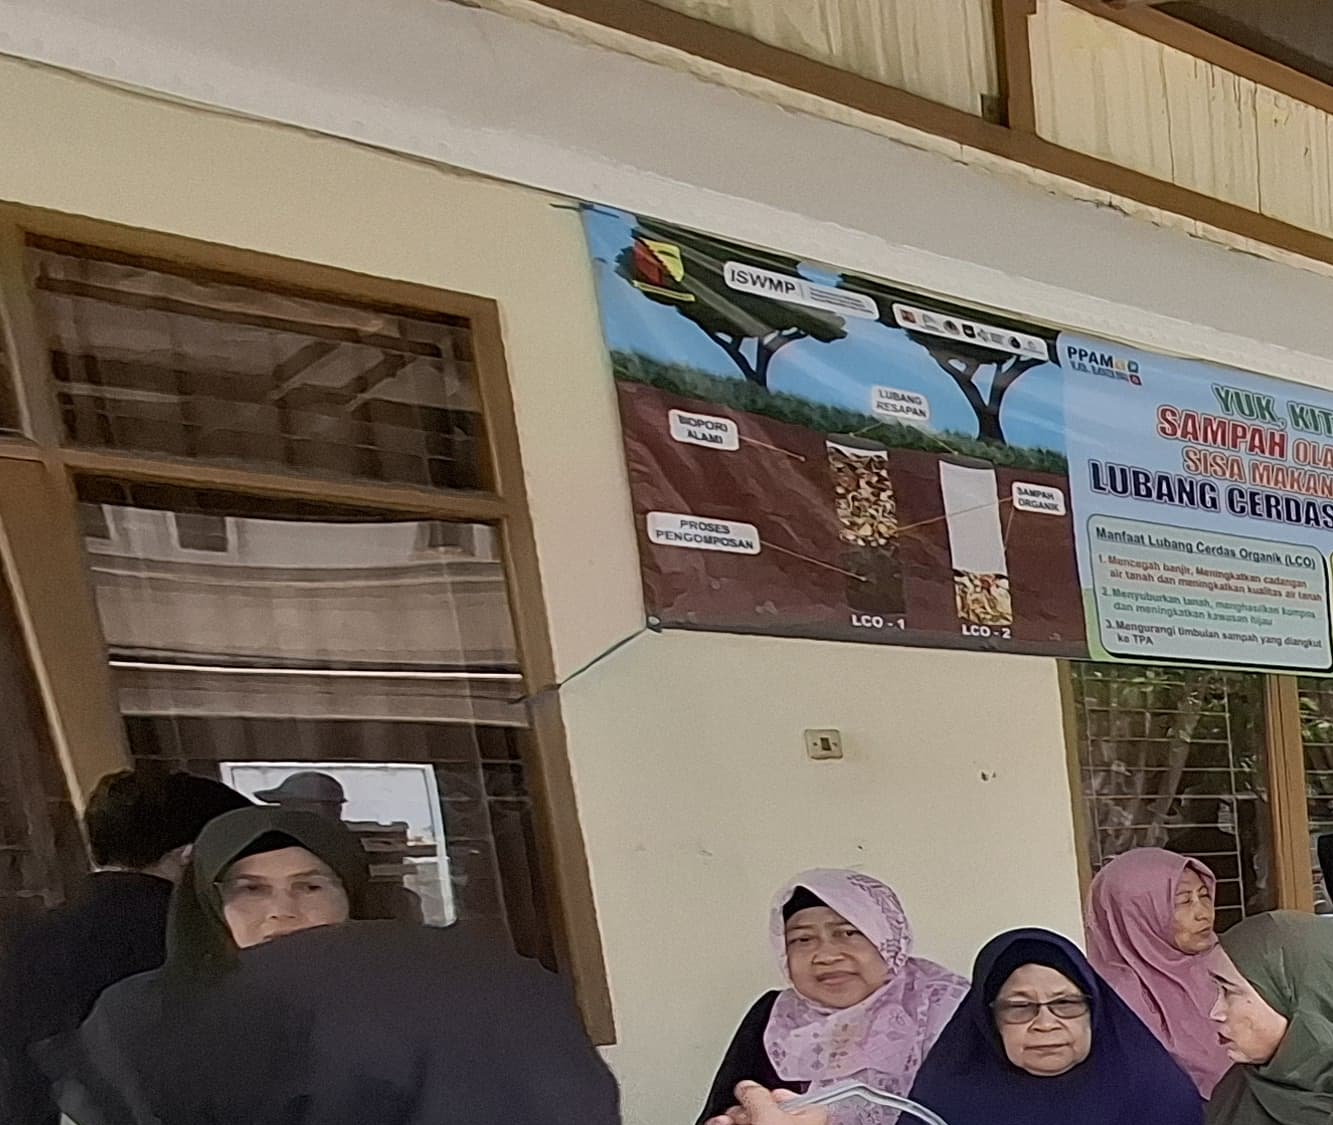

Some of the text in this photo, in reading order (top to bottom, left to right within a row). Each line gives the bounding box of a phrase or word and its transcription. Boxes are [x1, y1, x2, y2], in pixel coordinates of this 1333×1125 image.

[731, 269, 796, 295] ISWMP
[1067, 346, 1114, 369] PPAM
[1212, 383, 1287, 430] YUK,
[1157, 404, 1288, 460] SAMPAH
[1182, 446, 1245, 482] SISA
[1088, 459, 1220, 512] LUBANG
[680, 520, 730, 534] PROSES
[656, 530, 754, 549] PENGOMPOSAN
[1096, 527, 1316, 570] Manfaat Lubang Cerdas Organik (LCO)
[852, 614, 883, 628] LCO
[897, 619, 905, 630] 1
[962, 624, 990, 637] LCO
[1002, 628, 1011, 639] 2
[1116, 621, 1176, 637] Mengurangi
[1133, 635, 1154, 646] TPA
